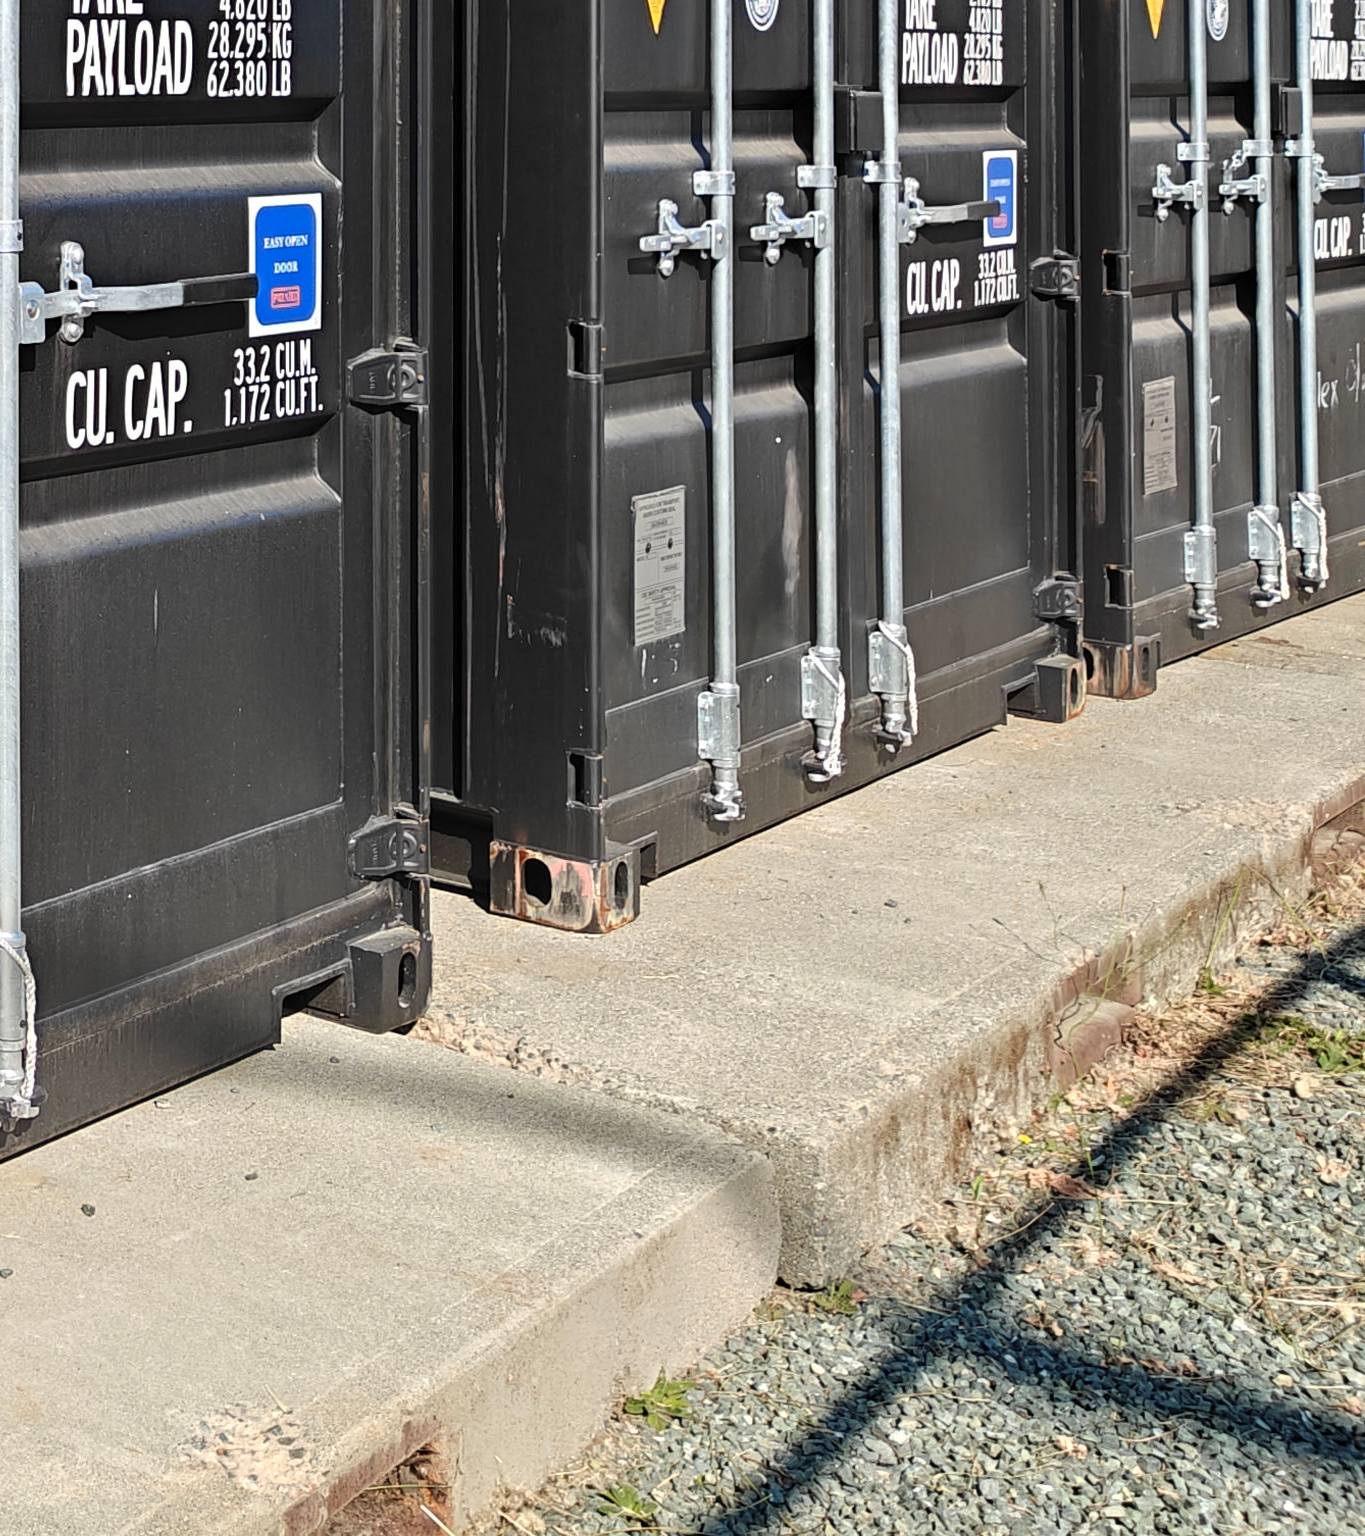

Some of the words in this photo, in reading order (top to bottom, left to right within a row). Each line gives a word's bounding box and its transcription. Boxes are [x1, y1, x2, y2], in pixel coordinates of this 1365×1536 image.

[66, 18, 194, 97] PAYLOAD
[207, 20, 267, 59] 28,295
[272, 22, 293, 59] KG
[271, 59, 292, 97] LB
[901, 31, 959, 85] PAYLOAD
[263, 236, 284, 249] EASY
[284, 234, 309, 248] OPEN
[1330, 216, 1353, 258] CAP.
[273, 260, 299, 274] DOOR
[906, 261, 929, 315] CU.
[931, 258, 962, 312] CAP.
[65, 367, 115, 450] CU.
[124, 359, 193, 441] CAP.
[233, 344, 271, 387] 33.2
[223, 383, 271, 427] 1,172
[275, 375, 324, 419] CU.FT.
